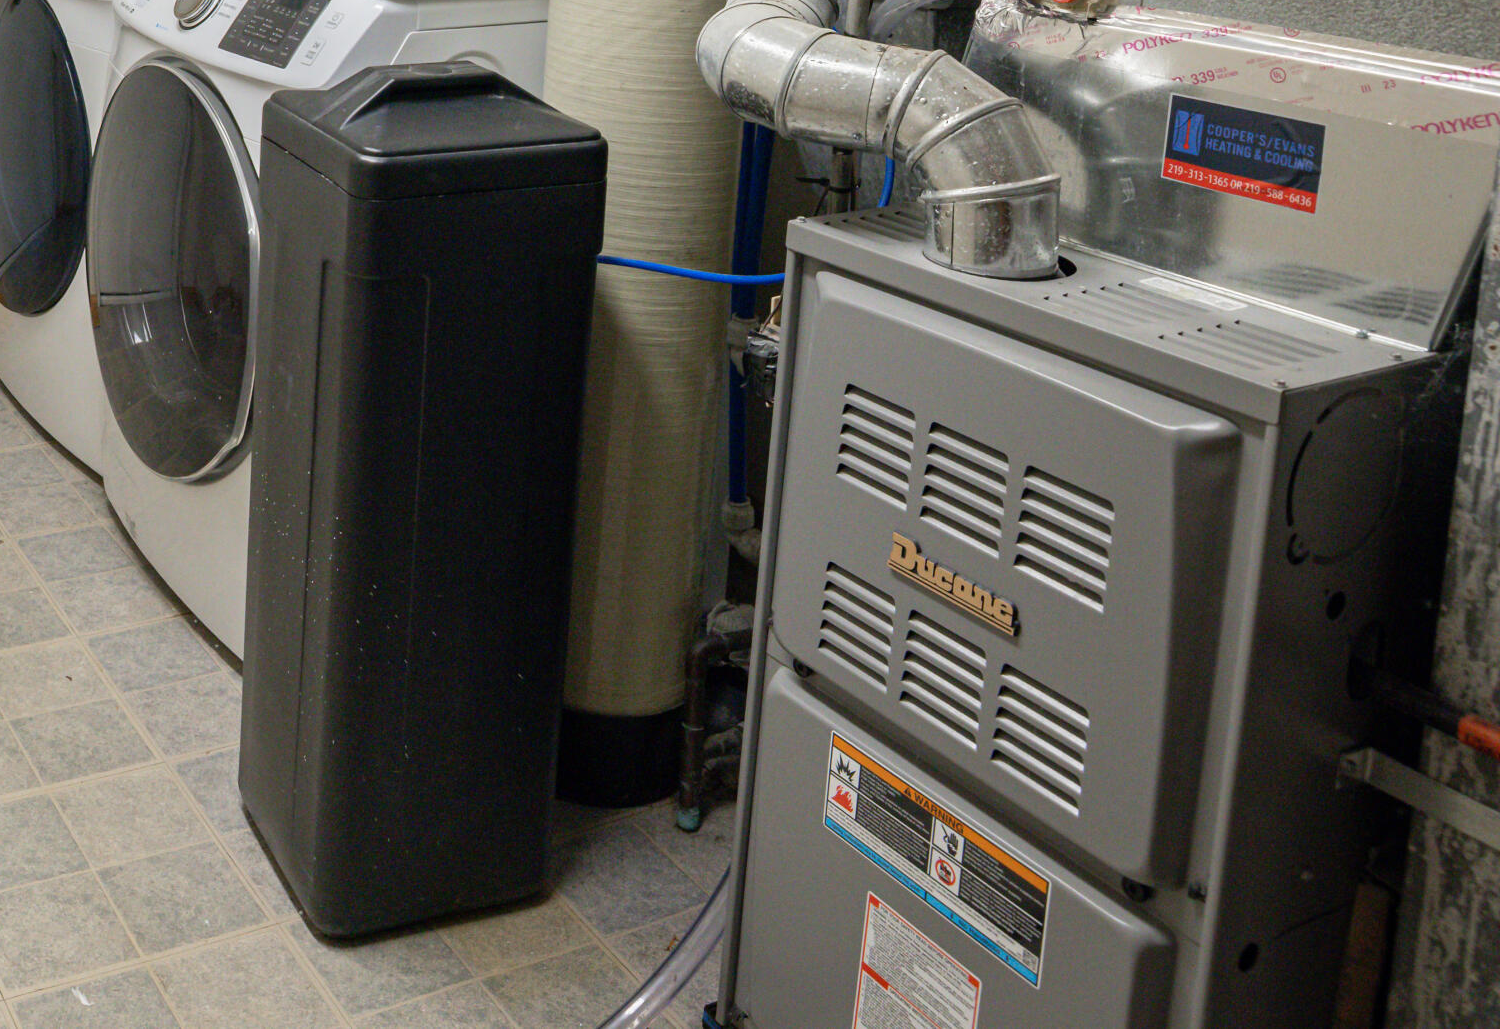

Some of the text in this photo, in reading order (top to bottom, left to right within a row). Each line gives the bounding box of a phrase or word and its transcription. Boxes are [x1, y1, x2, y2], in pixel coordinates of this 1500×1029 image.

[1190, 70, 1215, 85] 339
[1205, 137, 1315, 172] HEATING & COOLING
[1207, 123, 1315, 158] COOPER'S/EVANS
[1168, 164, 1312, 207] 219-313-1365 OR 219-588-6436
[890, 531, 1014, 627] Ducane
[914, 794, 964, 835] WARNING
